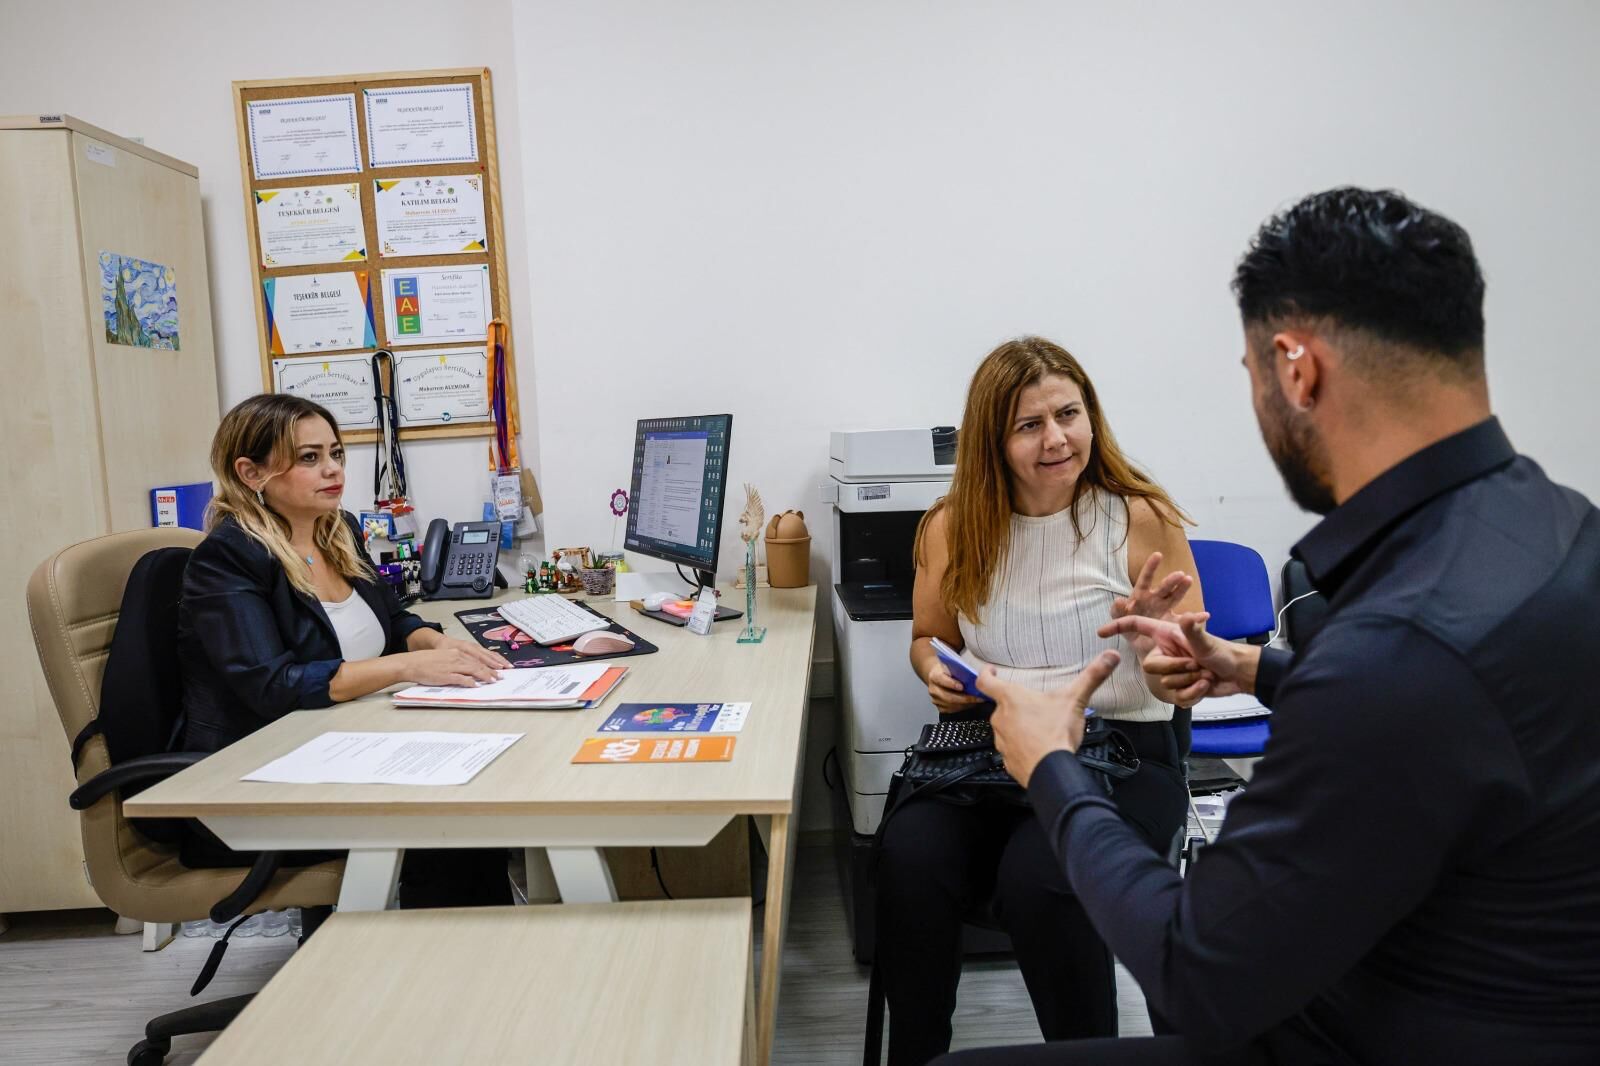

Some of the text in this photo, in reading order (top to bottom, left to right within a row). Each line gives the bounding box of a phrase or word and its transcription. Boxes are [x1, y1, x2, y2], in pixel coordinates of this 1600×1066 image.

[401, 196, 458, 207] KATILIM BELGESİ
[278, 204, 340, 217] TEŞEKKÜR BELGESİ
[400, 280, 414, 295] E
[293, 289, 341, 301] TEŞEKKÜR BELGESİ
[402, 317, 418, 332] E
